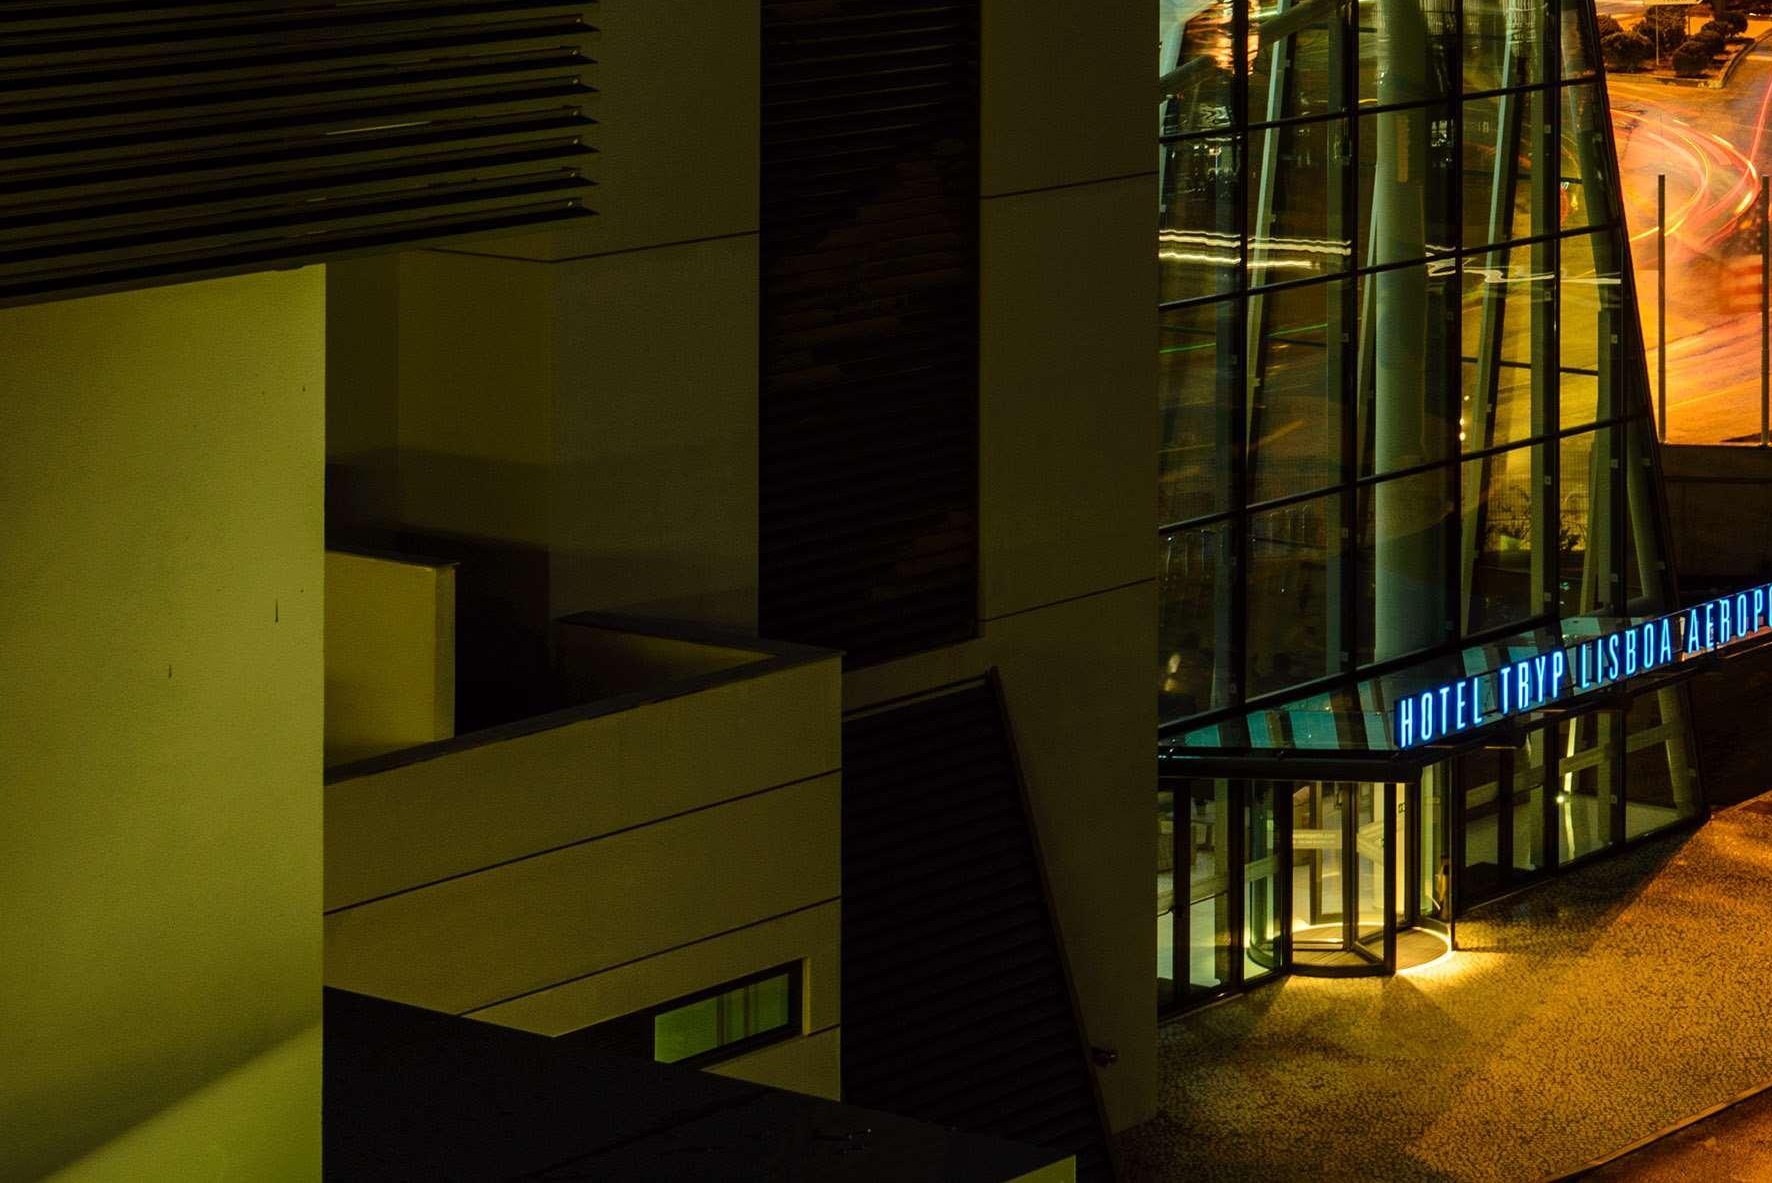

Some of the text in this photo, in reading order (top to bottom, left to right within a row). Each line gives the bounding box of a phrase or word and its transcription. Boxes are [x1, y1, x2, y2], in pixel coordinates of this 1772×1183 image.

[1400, 676, 1483, 749] HOTEL
[1500, 650, 1564, 715] TRYP
[1580, 617, 1673, 690] LISBOA
